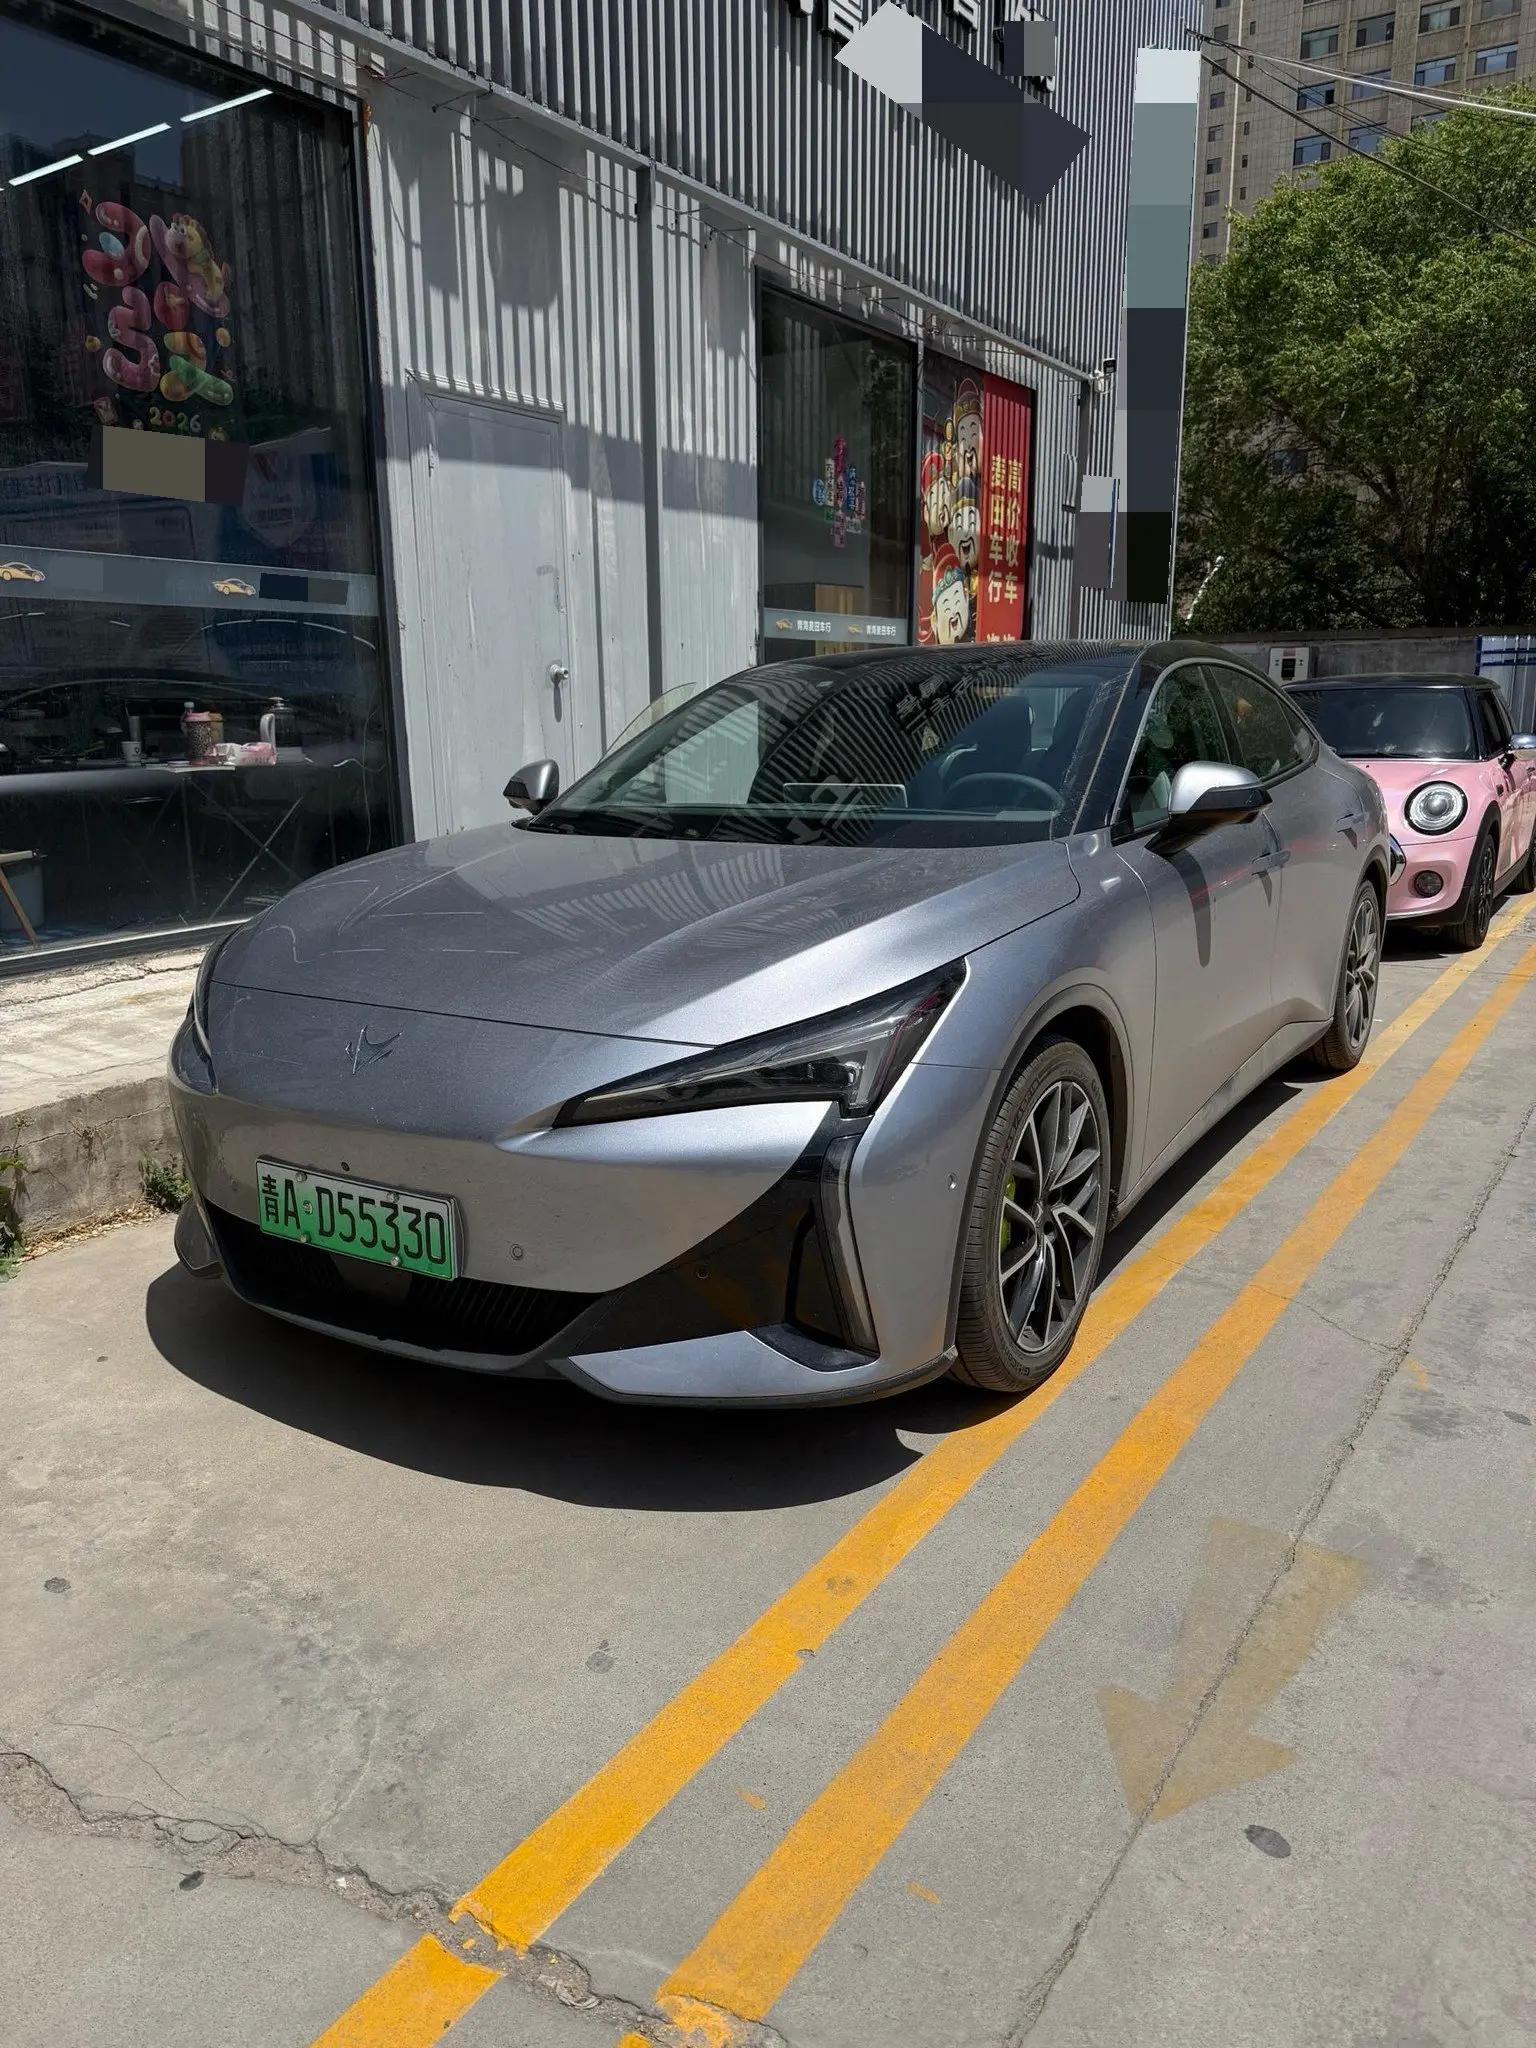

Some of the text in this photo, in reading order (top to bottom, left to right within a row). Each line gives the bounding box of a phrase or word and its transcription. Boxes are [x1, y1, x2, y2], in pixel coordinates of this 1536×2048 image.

[150, 406, 201, 433] 2026
[987, 454, 1006, 604] 麦田车行
[1003, 459, 1023, 605] 高价收车
